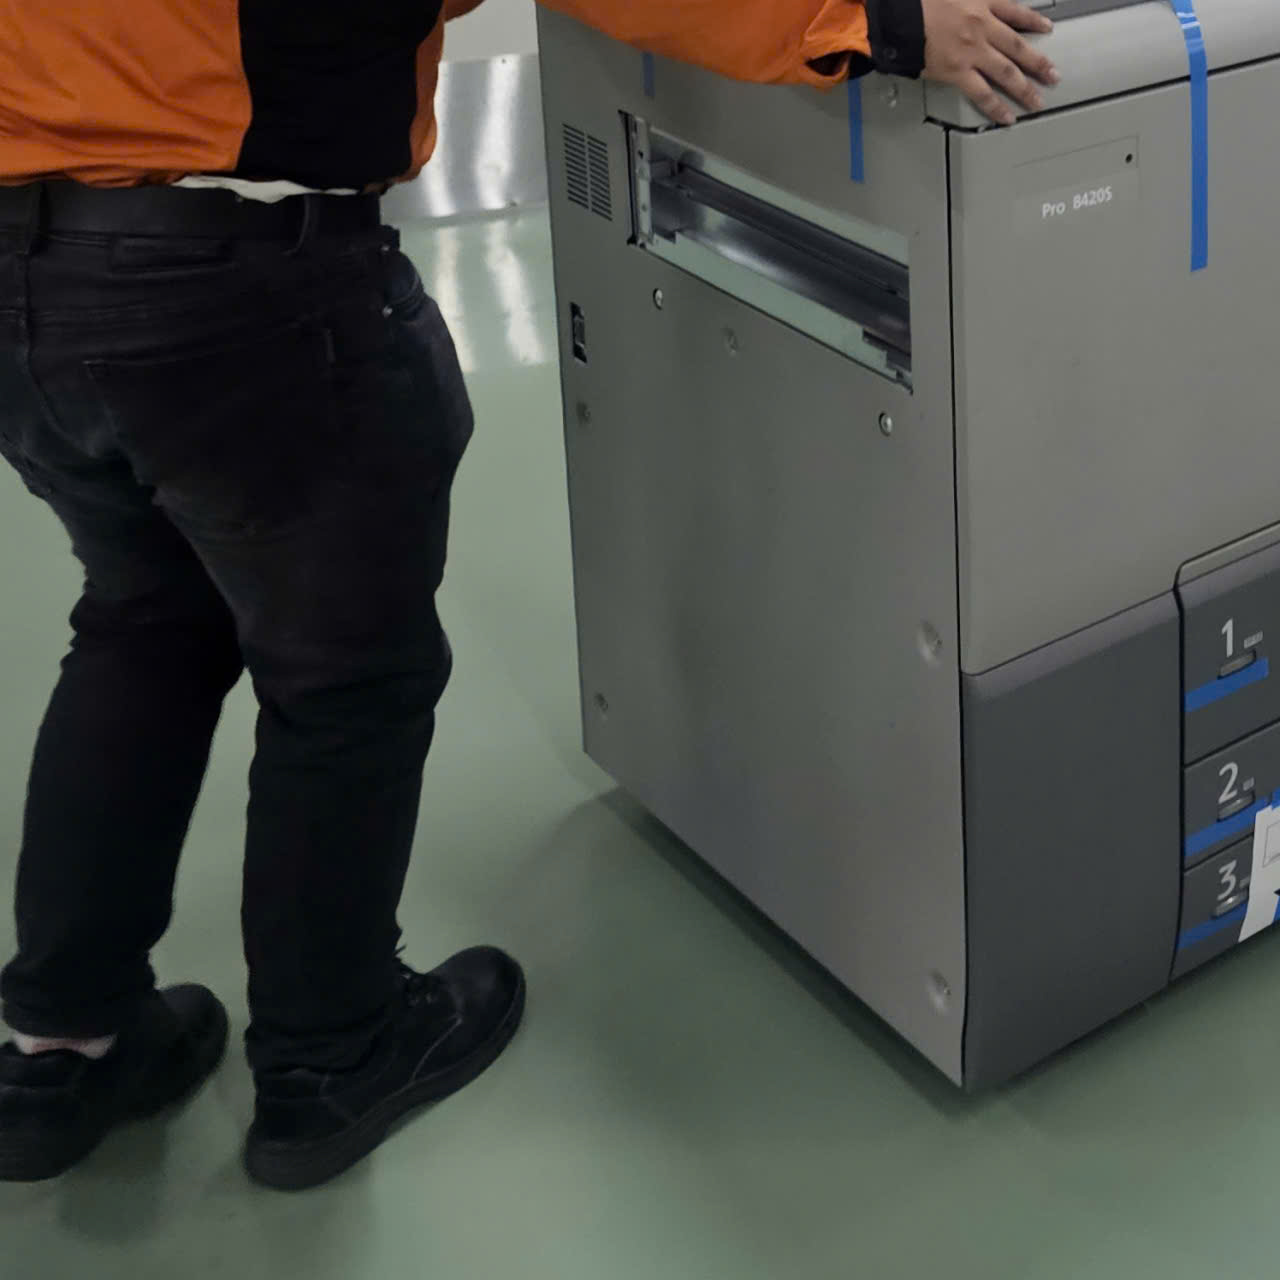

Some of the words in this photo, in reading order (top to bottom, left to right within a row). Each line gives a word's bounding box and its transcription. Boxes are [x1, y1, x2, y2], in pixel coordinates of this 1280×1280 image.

[1042, 202, 1066, 218] Pro
[1221, 617, 1234, 658] 1
[1218, 761, 1239, 805] 2
[1217, 859, 1238, 901] 3
